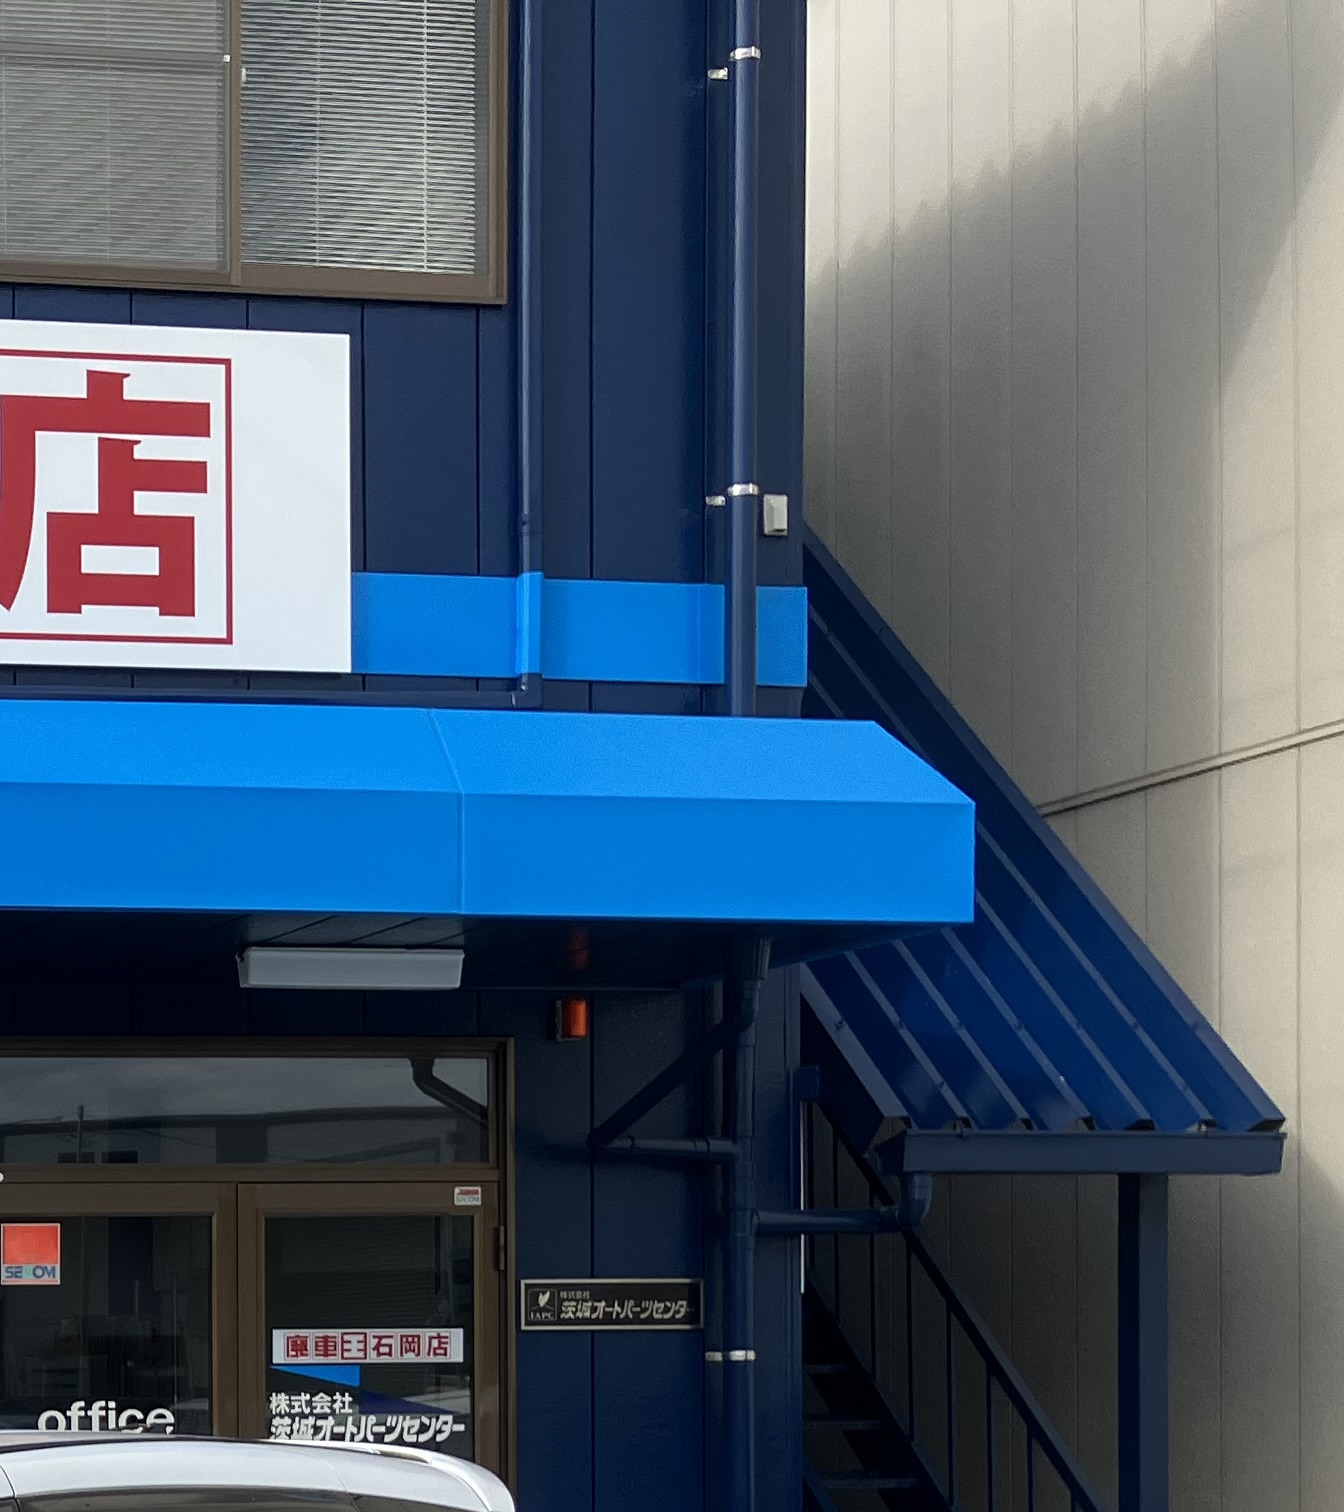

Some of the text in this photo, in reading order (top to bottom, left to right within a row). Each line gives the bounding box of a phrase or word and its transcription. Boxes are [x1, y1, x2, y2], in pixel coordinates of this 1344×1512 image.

[285, 1331, 451, 1360] 廃車王石岡店
[269, 1392, 353, 1414] 株式会社
[37, 1401, 175, 1435] office
